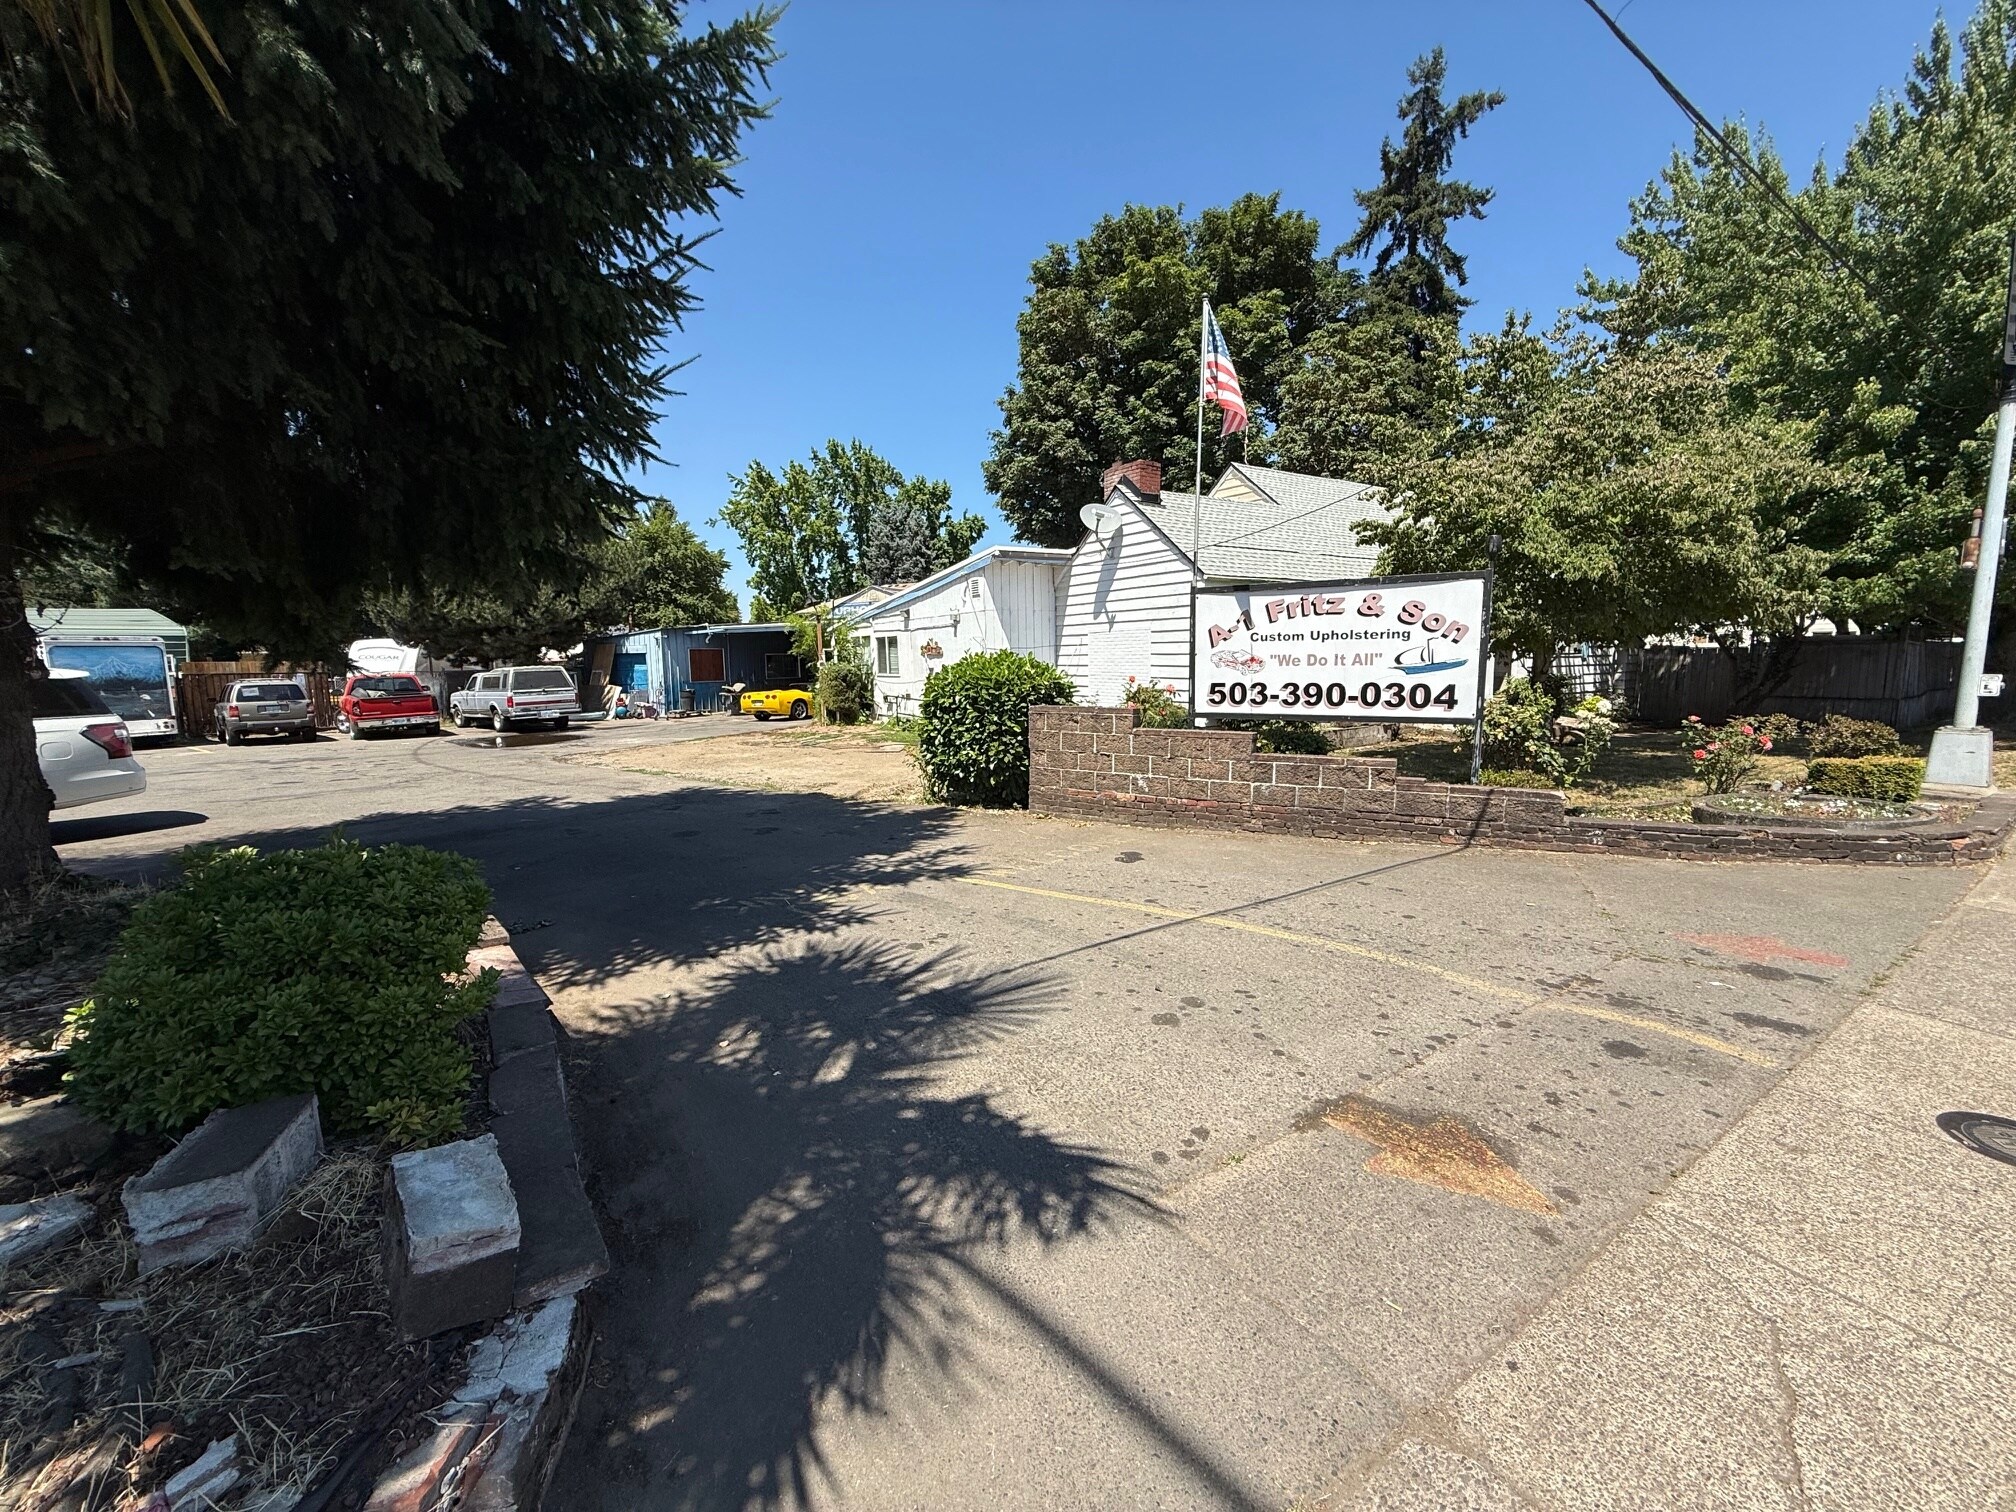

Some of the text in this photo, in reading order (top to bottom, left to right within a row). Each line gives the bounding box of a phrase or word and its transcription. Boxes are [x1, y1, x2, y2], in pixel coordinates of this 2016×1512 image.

[1208, 593, 1470, 648] A-1 Fritz & Son
[1250, 629, 1411, 642] Custom Upholstering
[1270, 653, 1382, 666] "We Do It All"
[1207, 682, 1459, 711] 503-390-0304
